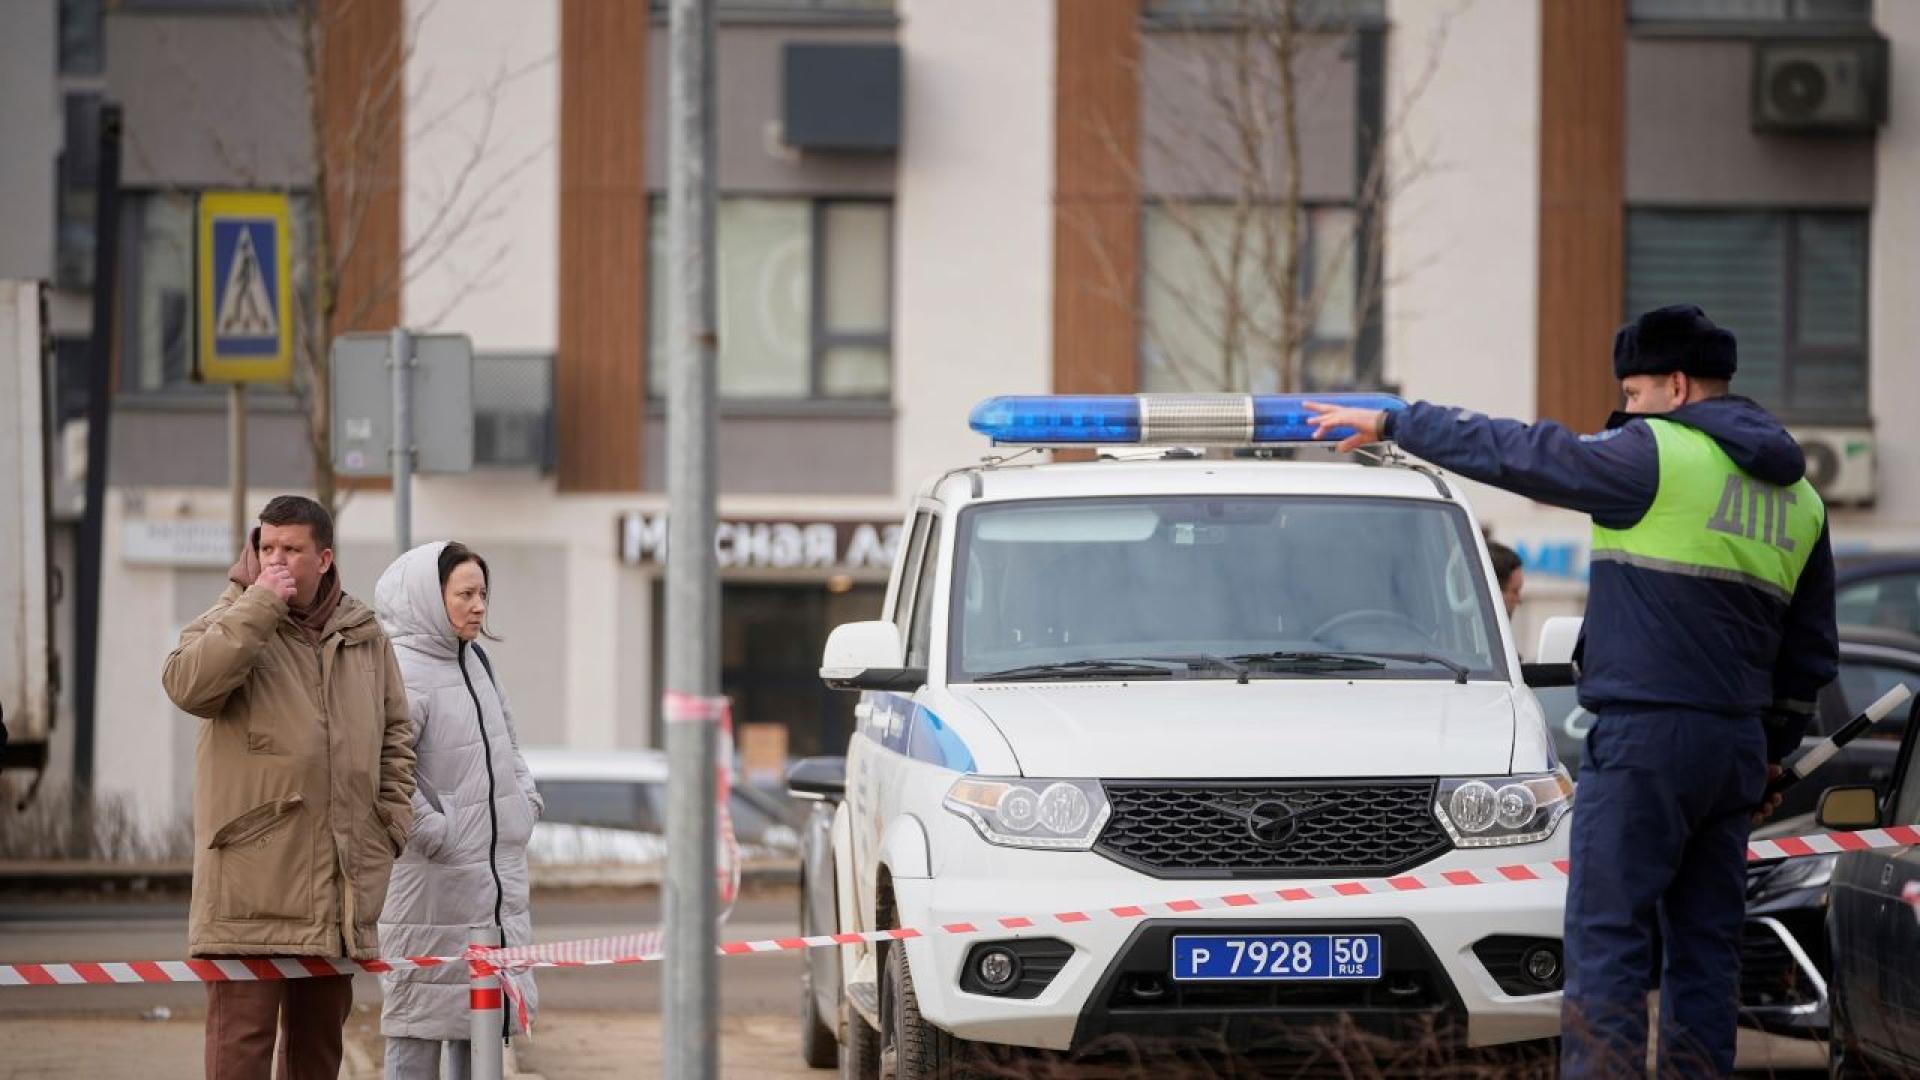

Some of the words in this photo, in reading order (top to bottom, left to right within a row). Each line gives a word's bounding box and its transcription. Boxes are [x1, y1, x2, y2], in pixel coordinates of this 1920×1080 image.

[1705, 473, 1798, 552] ДПС
[623, 512, 837, 567] Мсная
[1226, 941, 1312, 974] 7928
[1334, 938, 1368, 964] 50
[1338, 964, 1364, 975] RUS
